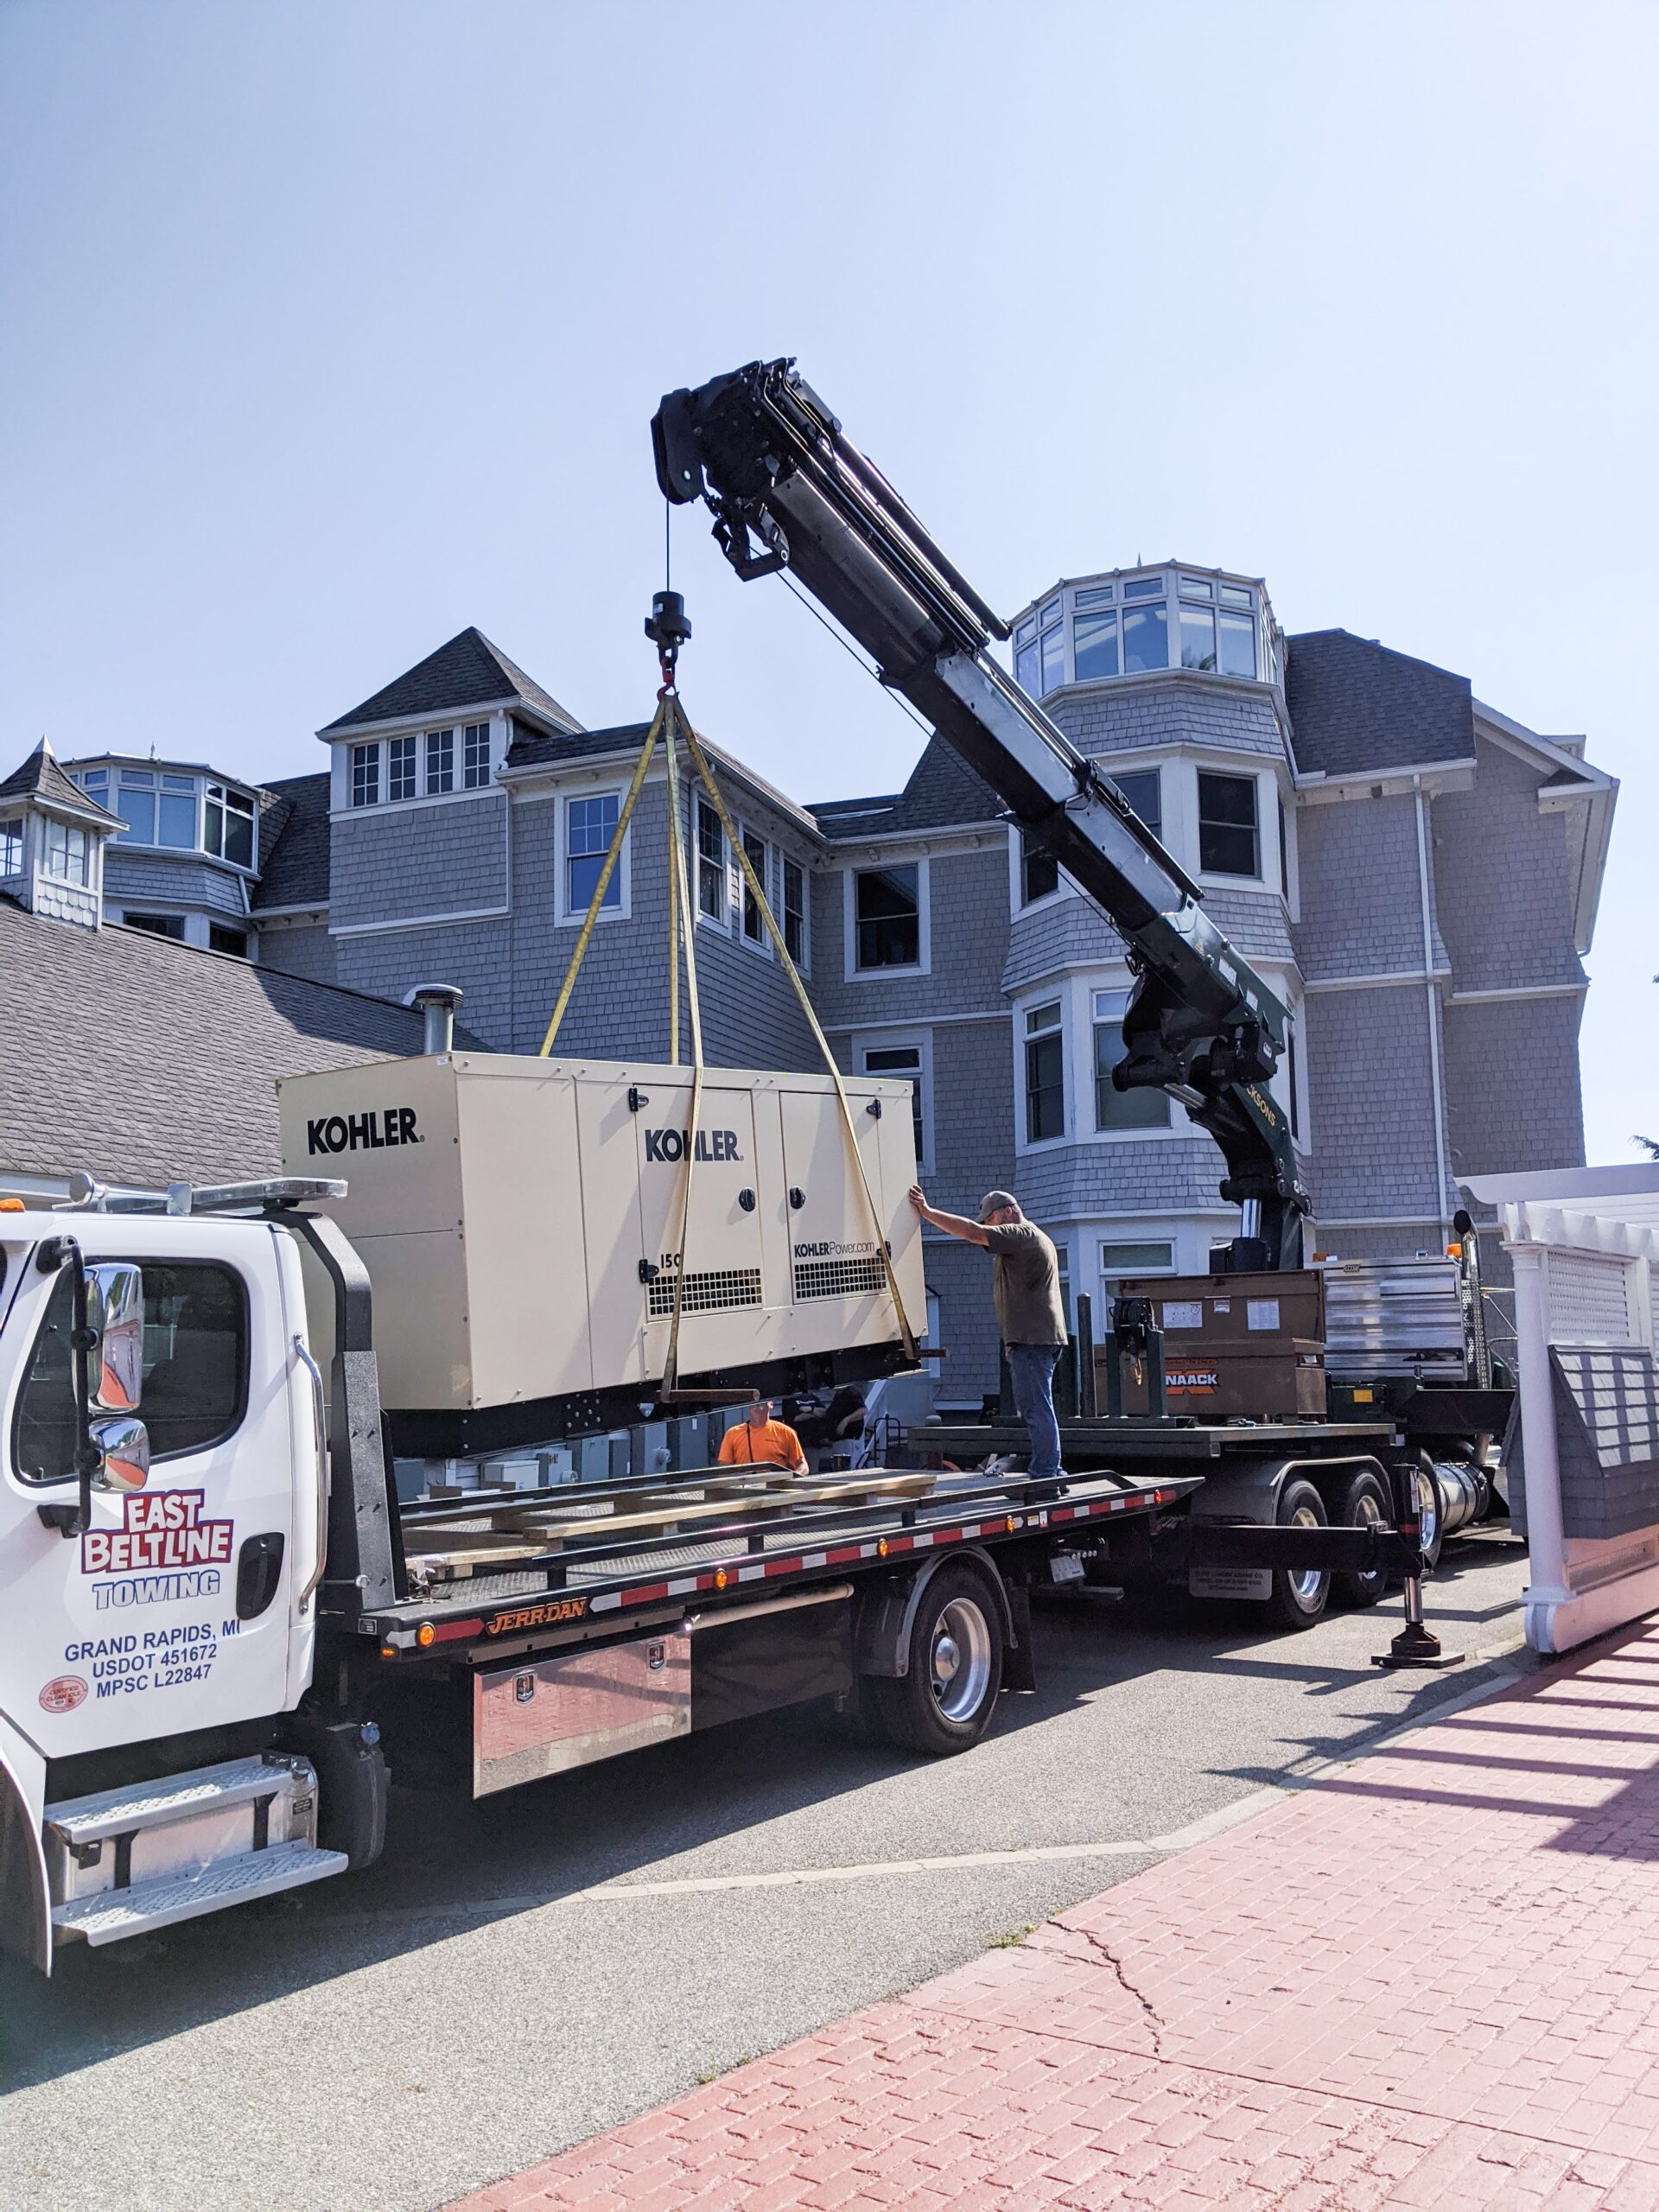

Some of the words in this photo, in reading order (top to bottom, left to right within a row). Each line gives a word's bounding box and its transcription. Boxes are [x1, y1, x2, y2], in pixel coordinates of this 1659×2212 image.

[307, 1107, 420, 1155] KOHLER
[645, 1128, 741, 1162] KOHLER
[793, 1241, 875, 1258] KOHLERPower.com
[1165, 1374, 1217, 1385] NAACK
[126, 1492, 203, 1534] EAST
[83, 1523, 232, 1573] BELTLINE
[92, 1569, 220, 1610] TOWING
[65, 1635, 137, 1662] GRAND
[143, 1623, 217, 1649] RAPIDS,
[222, 1618, 241, 1636] MI
[92, 1654, 156, 1678] USDOT
[160, 1643, 217, 1666] 451672
[97, 1675, 148, 1698] MPSC
[154, 1663, 212, 1688] L22847
